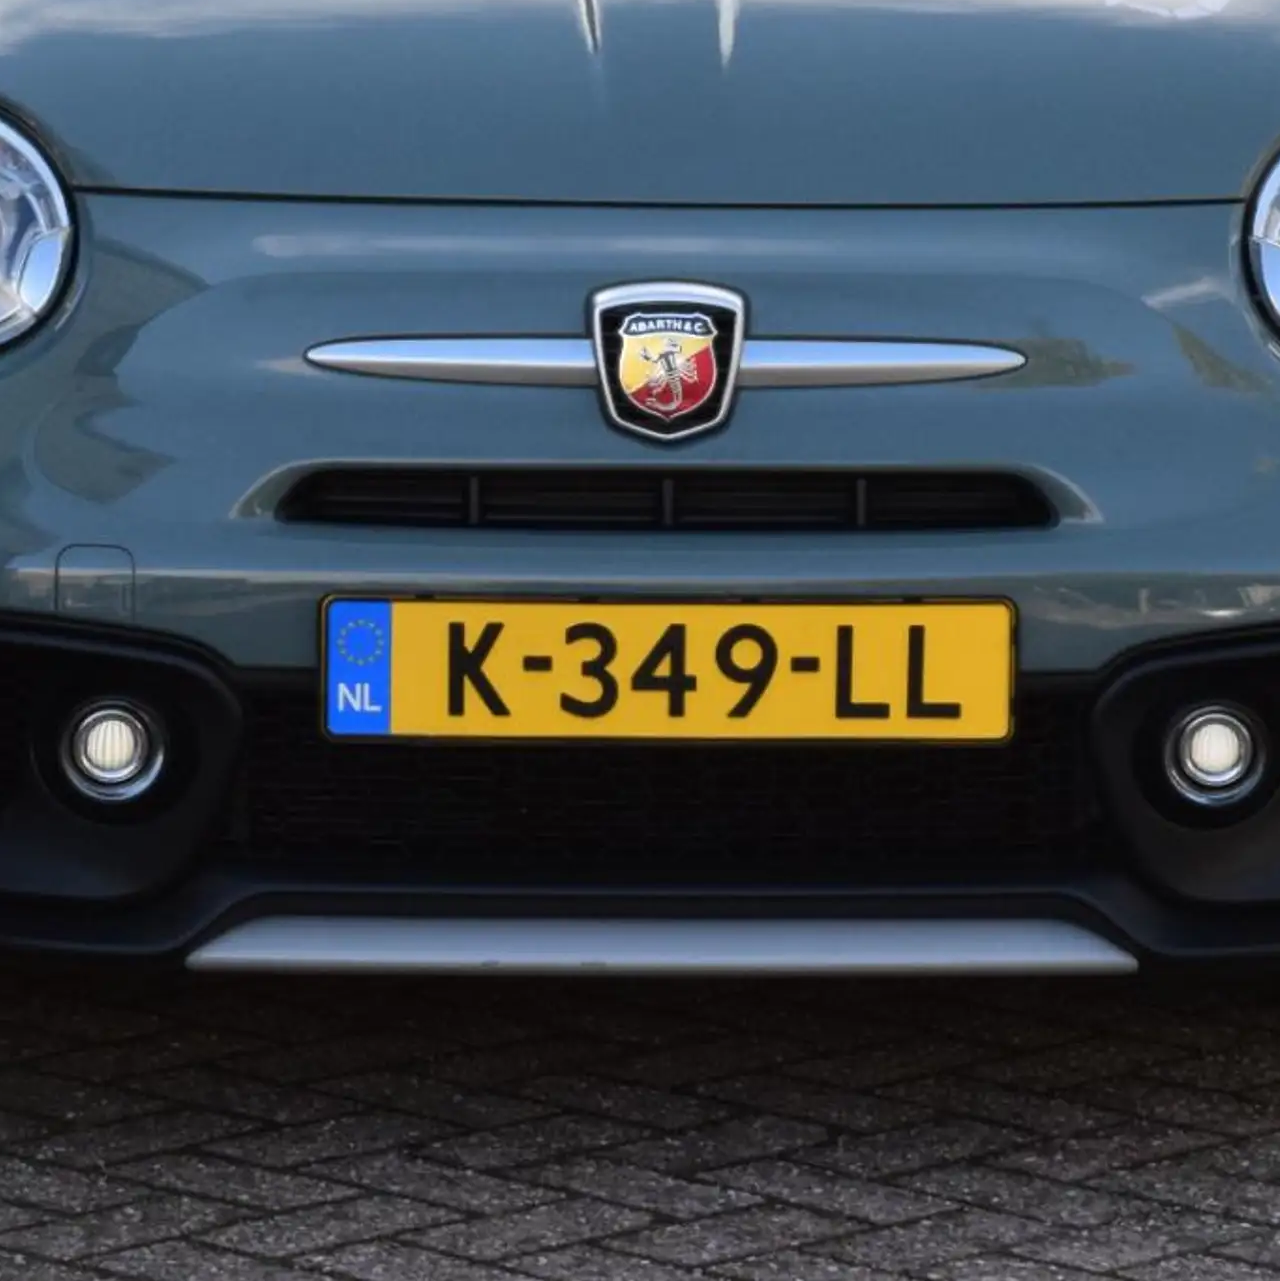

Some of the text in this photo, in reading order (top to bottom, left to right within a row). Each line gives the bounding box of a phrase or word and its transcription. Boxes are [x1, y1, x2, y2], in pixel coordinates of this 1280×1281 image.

[629, 319, 682, 333] ABARTH
[447, 621, 962, 719] K-349-LL
[337, 682, 382, 712] NL
